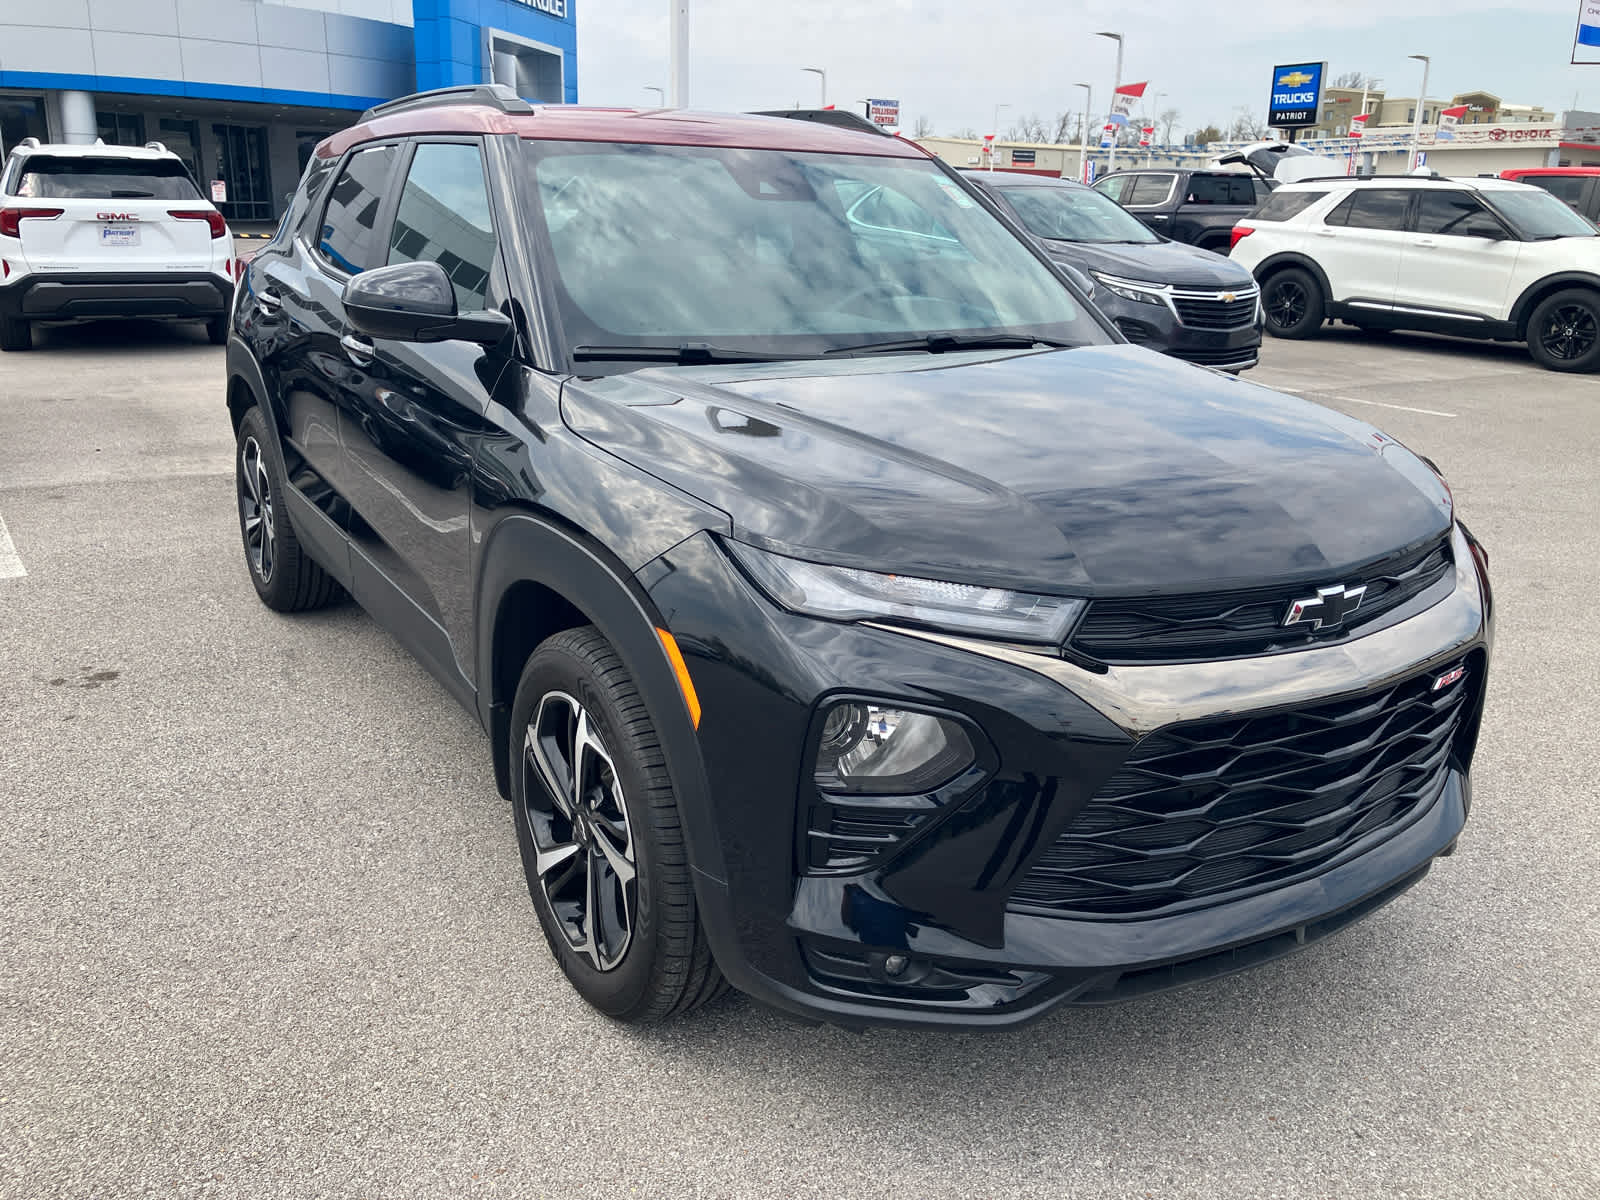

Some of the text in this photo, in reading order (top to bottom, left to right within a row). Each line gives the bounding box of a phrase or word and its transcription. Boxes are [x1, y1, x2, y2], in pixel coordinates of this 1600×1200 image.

[1273, 92, 1314, 105] TRUCKS
[871, 107, 899, 115] COLLISION
[1275, 111, 1307, 120] PATRIOT
[873, 115, 895, 124] CENTER
[1507, 129, 1552, 139] TOYOTA
[96, 212, 140, 221] GMC
[103, 229, 136, 238] PATRIOT
[1435, 667, 1464, 689] RS
